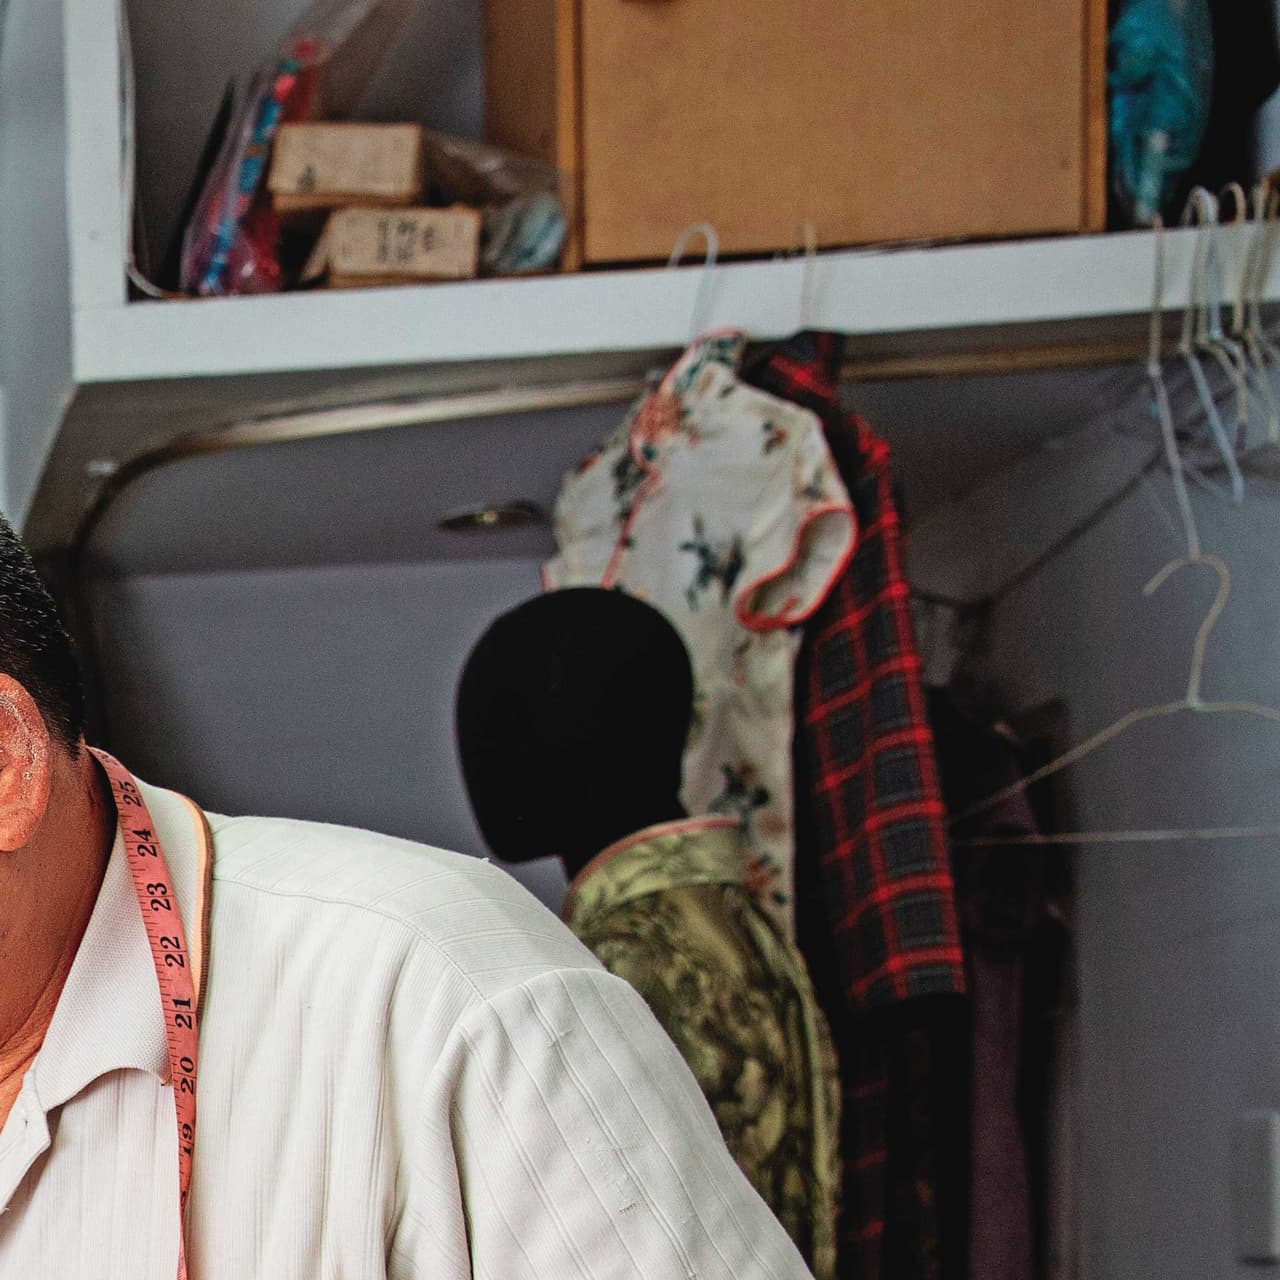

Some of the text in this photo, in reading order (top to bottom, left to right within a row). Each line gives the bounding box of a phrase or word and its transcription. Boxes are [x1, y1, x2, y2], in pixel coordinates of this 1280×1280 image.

[118, 781, 142, 808] 25
[132, 829, 158, 857] 24
[147, 882, 171, 911] 23
[160, 936, 185, 968] 22
[174, 997, 193, 1030] 21
[180, 1056, 195, 1094] 20
